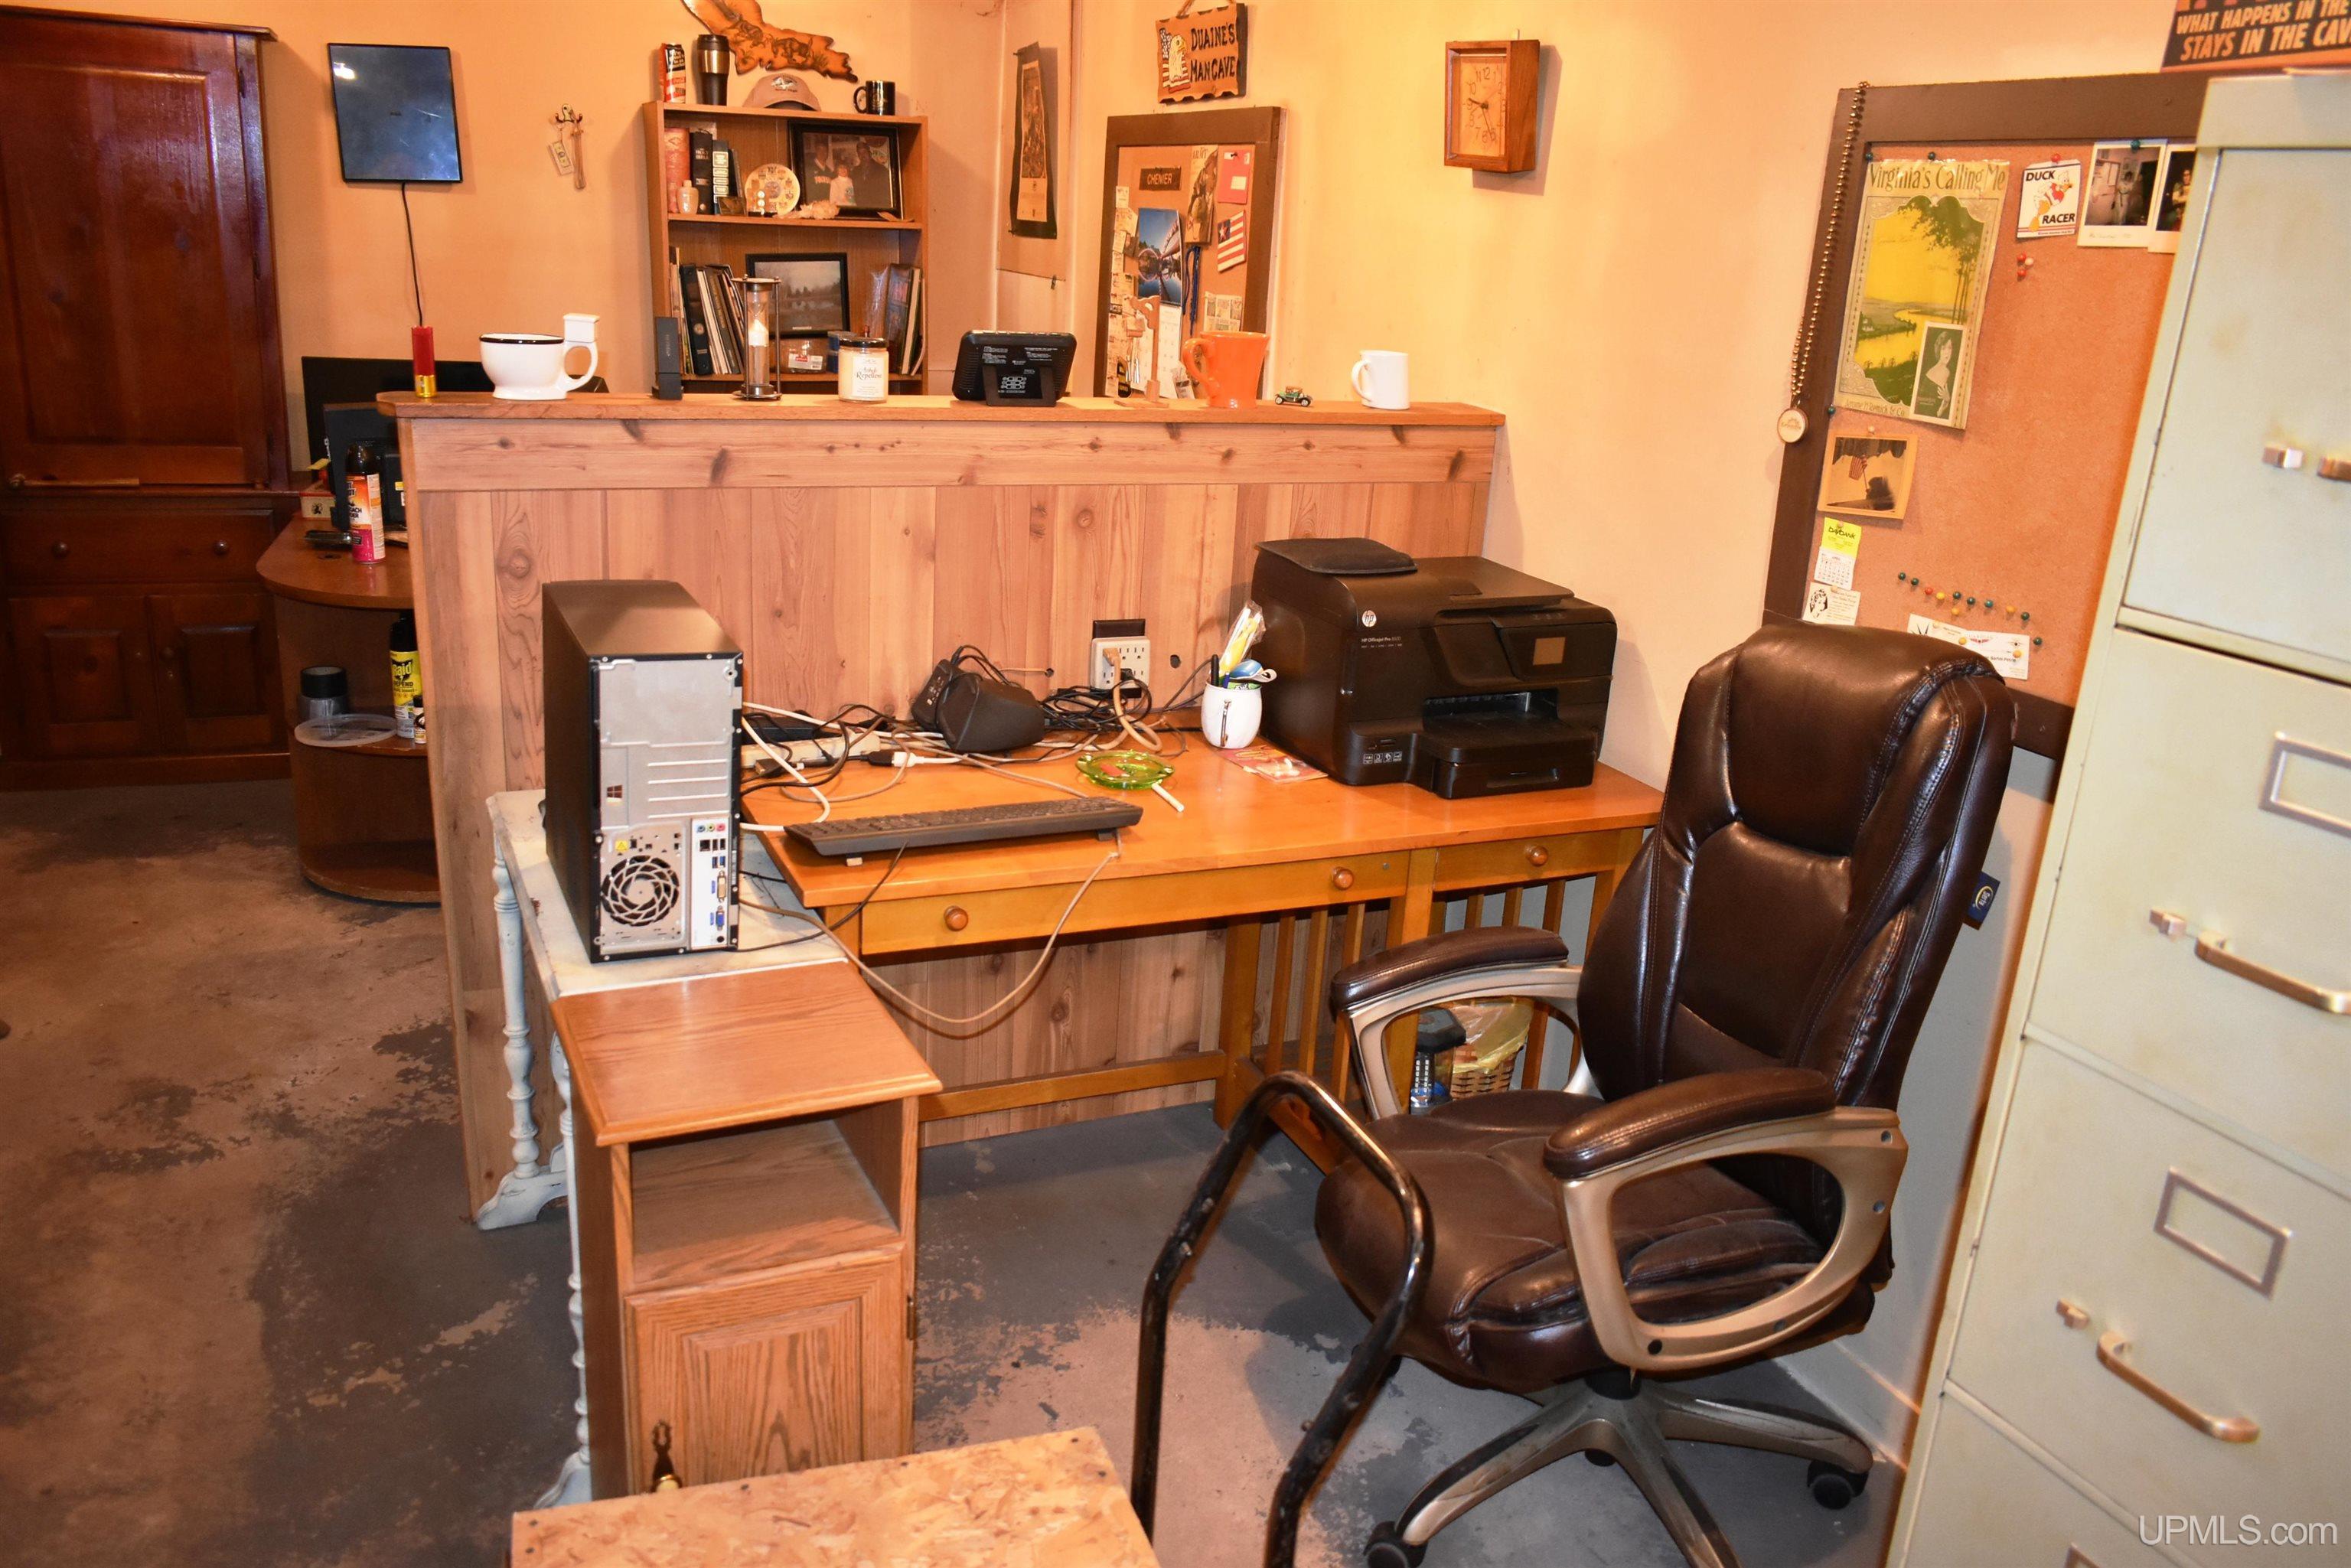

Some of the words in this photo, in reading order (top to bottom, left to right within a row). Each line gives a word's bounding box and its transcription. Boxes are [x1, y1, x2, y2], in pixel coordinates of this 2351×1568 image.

[2176, 11, 2219, 35] WHAT
[2220, 3, 2293, 30] HAPPENS
[2296, 0, 2316, 21] IN
[2320, 0, 2348, 18] THE
[1190, 23, 1235, 51] DUAINE'S
[2180, 31, 2236, 61] STAYS
[2239, 28, 2265, 55] IN
[2269, 23, 2310, 51] THE
[2313, 17, 2351, 46] CAV
[1147, 174, 1173, 185] CHENIER
[1870, 164, 1931, 191] Virginia's
[1936, 164, 1984, 194] Calling
[1984, 165, 2005, 191] Me
[2026, 170, 2056, 181] DUCK
[2042, 214, 2075, 224] RACER
[391, 661, 412, 676] Raid
